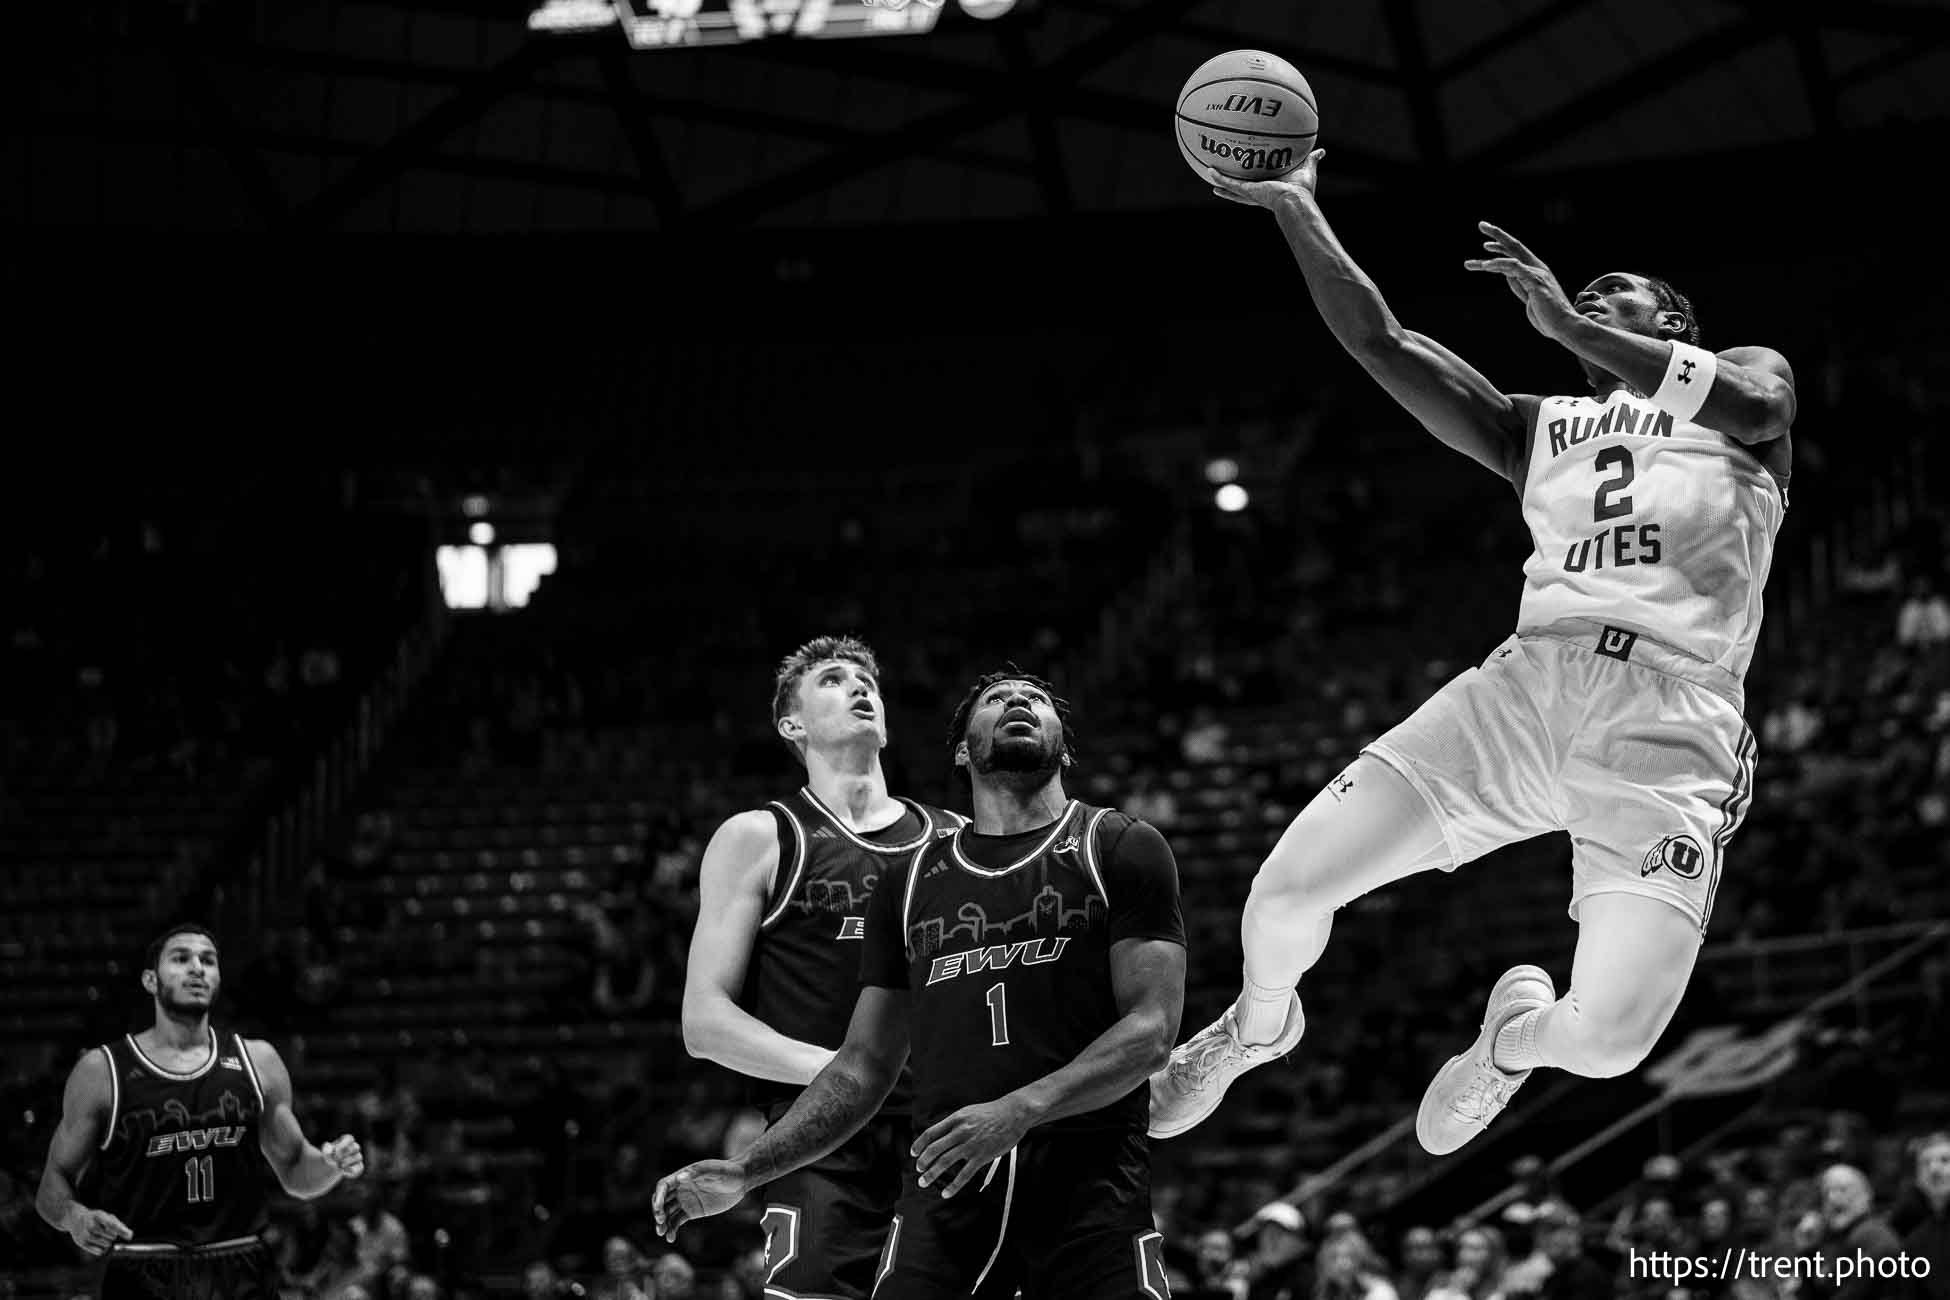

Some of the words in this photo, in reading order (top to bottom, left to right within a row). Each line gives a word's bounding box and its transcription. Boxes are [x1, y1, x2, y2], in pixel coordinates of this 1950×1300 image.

[1223, 94, 1283, 118] EVO
[1200, 134, 1293, 170] Wilson
[1548, 402, 1674, 458] RUNNIN
[1593, 444, 1635, 523] 2
[1563, 523, 1662, 573] UTES
[1603, 630, 1630, 653] U
[1670, 840, 1701, 875] U
[925, 937, 1072, 987] EWU
[986, 982, 1010, 1046] 1
[146, 1126, 247, 1158] EWU
[184, 1154, 215, 1203] 11
